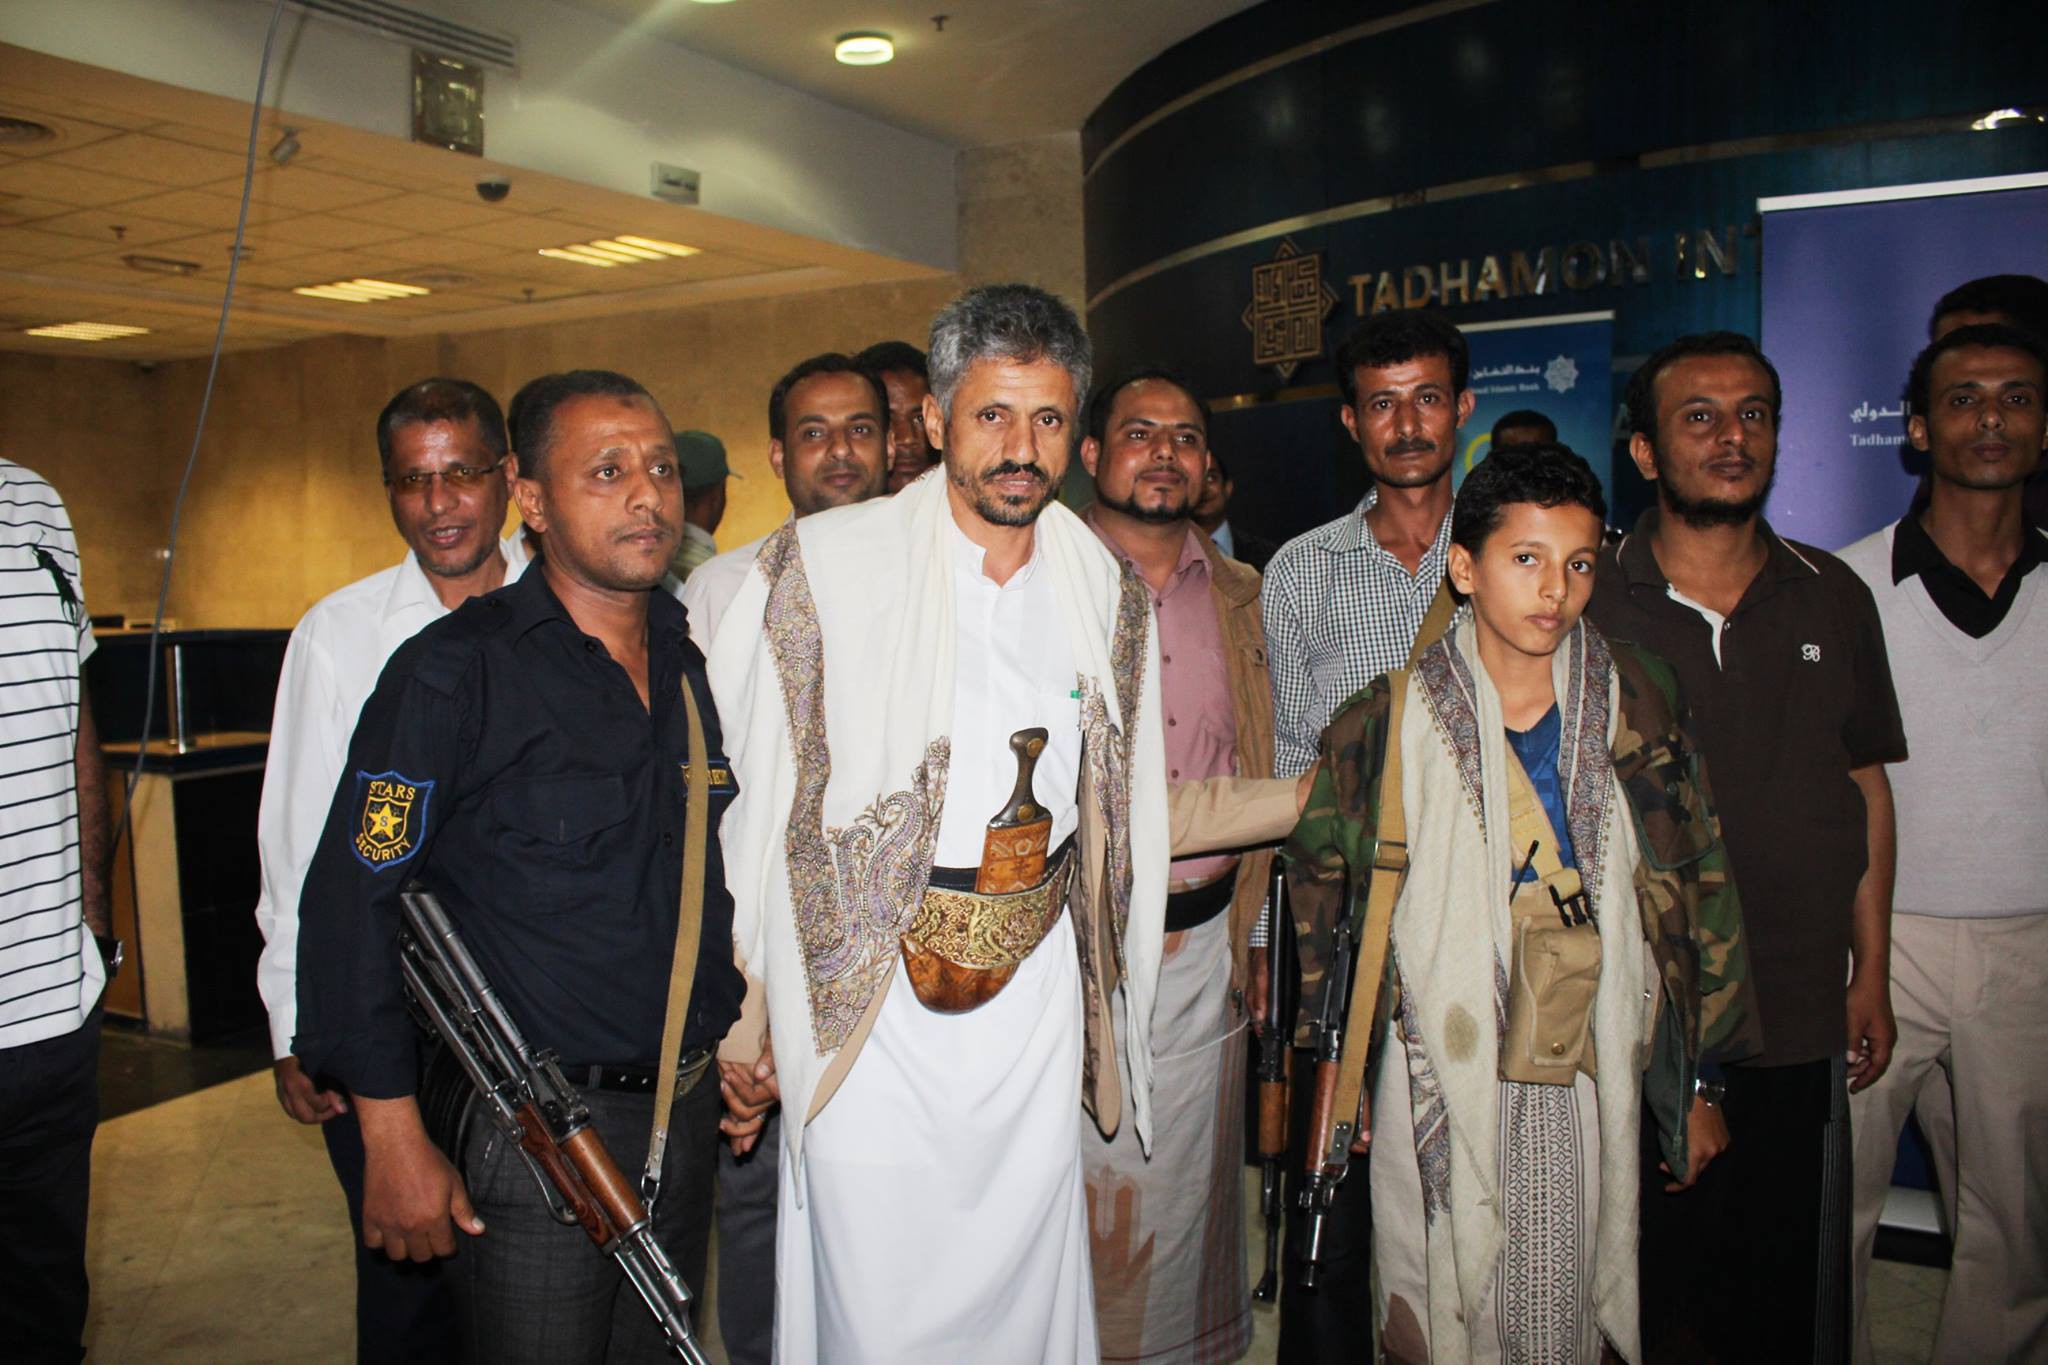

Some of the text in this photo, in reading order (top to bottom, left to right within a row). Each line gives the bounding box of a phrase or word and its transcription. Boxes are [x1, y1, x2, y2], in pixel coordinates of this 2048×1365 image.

[1347, 234, 1650, 318] TADHAMON
[1850, 433, 1906, 447] Tadham
[369, 781, 416, 800] STARS
[380, 815, 388, 827] S
[356, 833, 411, 860] SECURITY
